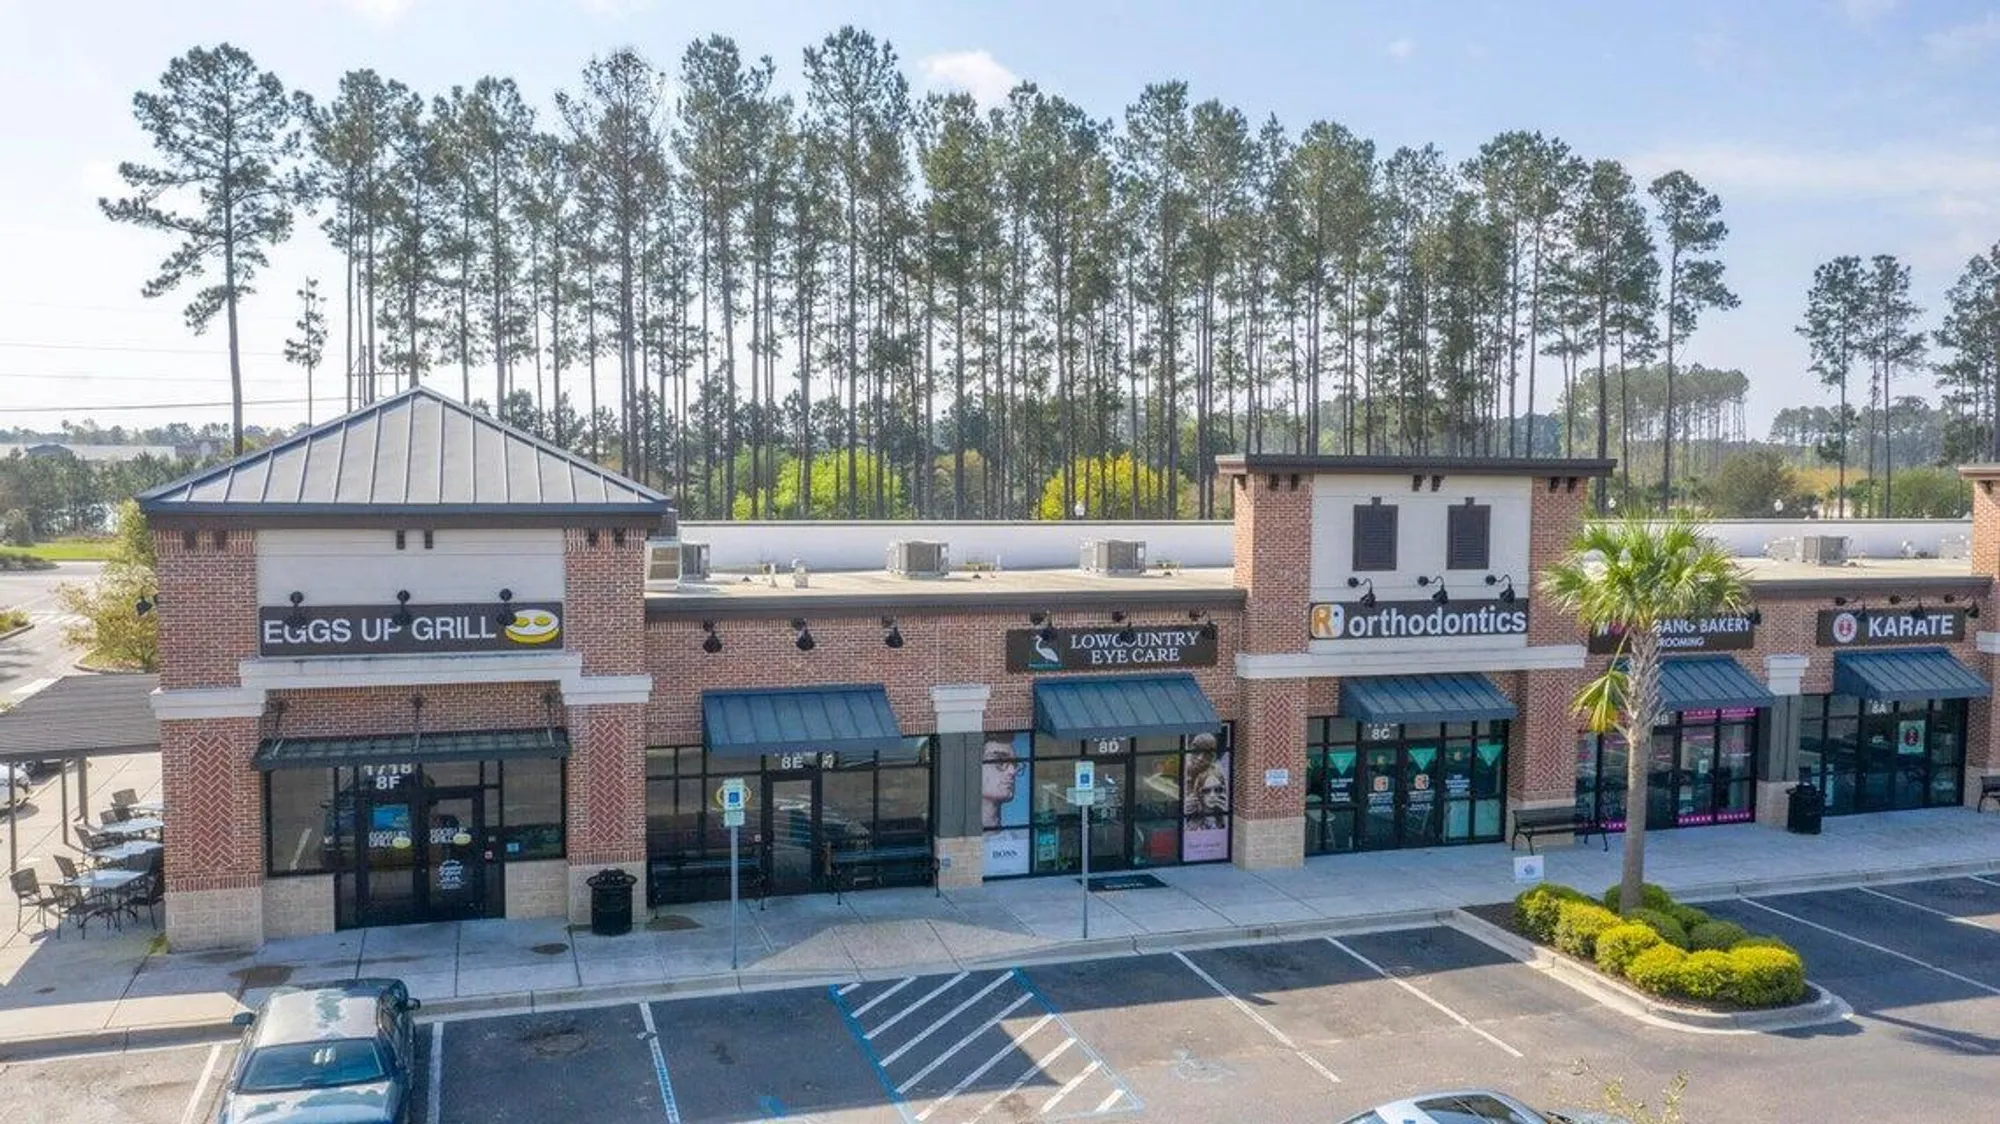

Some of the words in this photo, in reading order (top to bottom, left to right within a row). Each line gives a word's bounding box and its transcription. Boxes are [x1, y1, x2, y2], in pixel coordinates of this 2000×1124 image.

[1348, 605, 1527, 637] orthodontics
[1699, 617, 1750, 634] BAKERY
[1868, 614, 1955, 637] KARATE
[263, 618, 352, 644] EGGS
[361, 618, 401, 642] UP
[411, 616, 497, 641] GRILL
[1091, 649, 1129, 664] EYE
[1132, 648, 1181, 664] CARE
[1371, 728, 1391, 740] 8C
[1099, 741, 1120, 753] 8D
[781, 756, 804, 769] 8E
[375, 775, 402, 790] 8F
